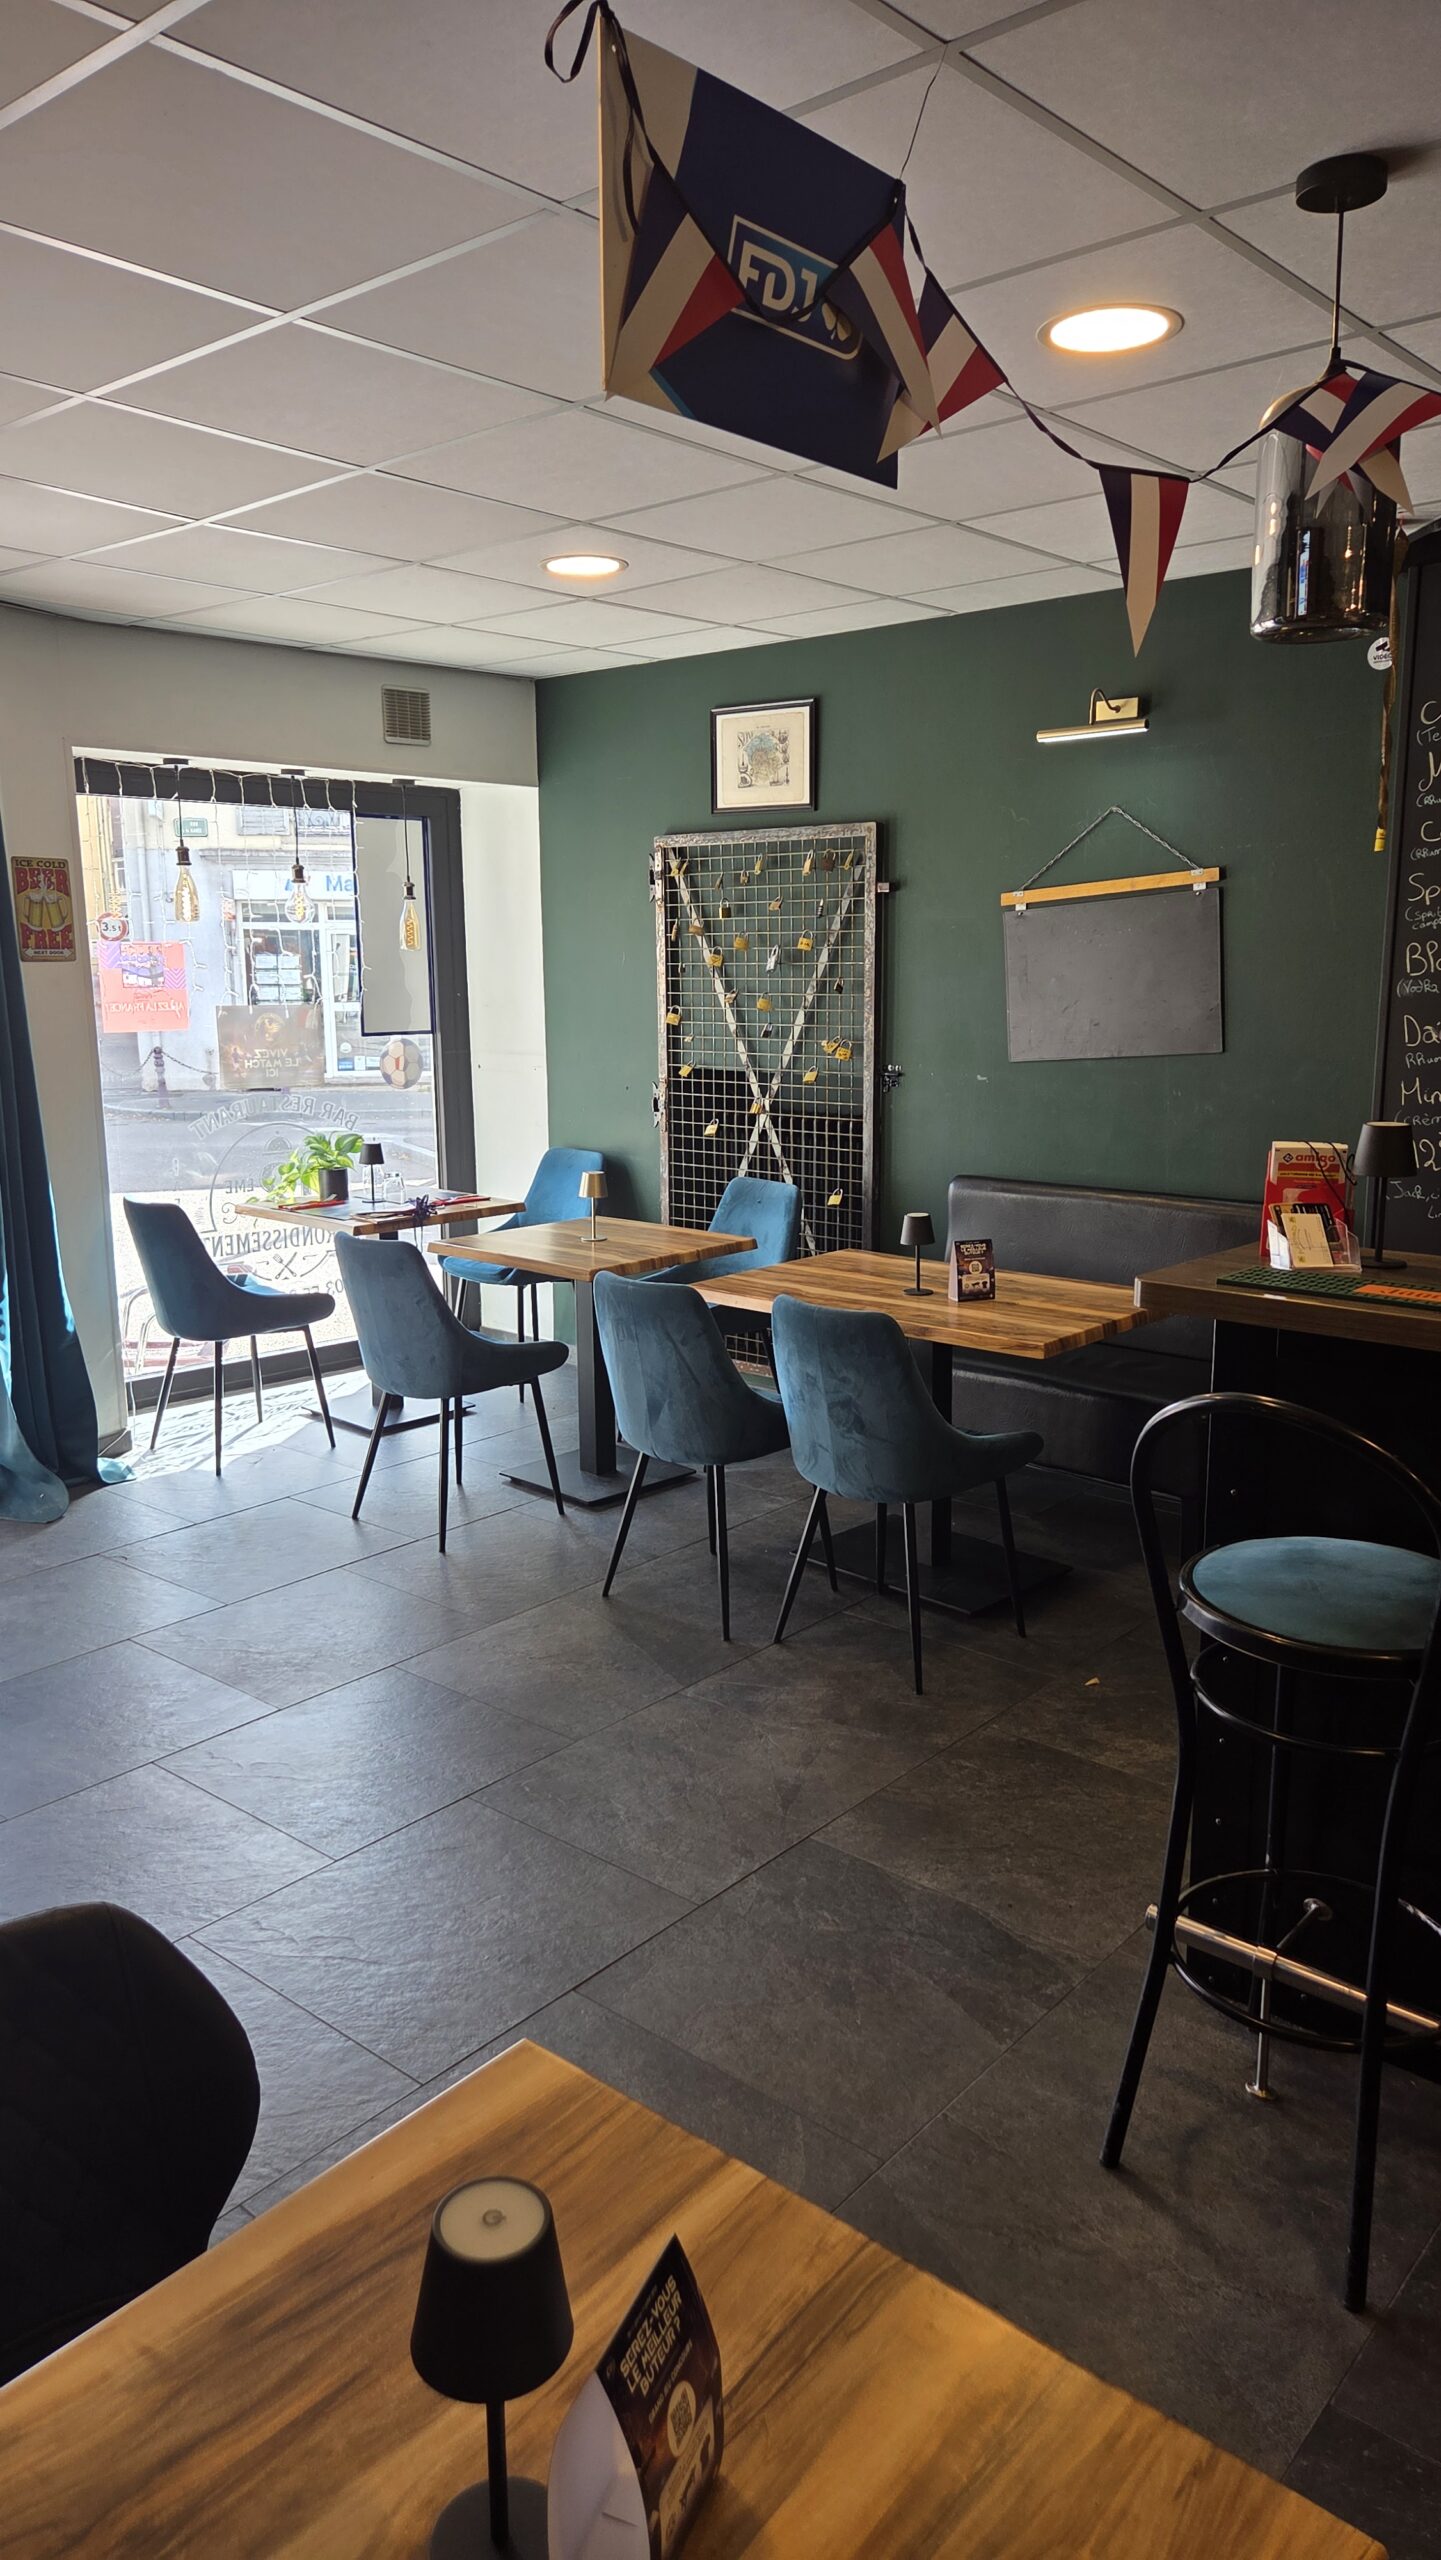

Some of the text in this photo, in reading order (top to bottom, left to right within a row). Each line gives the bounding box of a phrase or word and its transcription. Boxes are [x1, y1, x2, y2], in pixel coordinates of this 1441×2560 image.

[739, 240, 818, 322] FDJ
[15, 859, 66, 869] ICE COLD
[15, 867, 70, 896] BEER
[326, 875, 353, 892] Ma
[20, 923, 73, 949] FREE
[620, 2274, 677, 2378] SEREZ-VOUS
[627, 2366, 641, 2393] LE
[641, 2290, 682, 2369] MEILLEUR
[640, 2326, 676, 2397] BUTEUR
